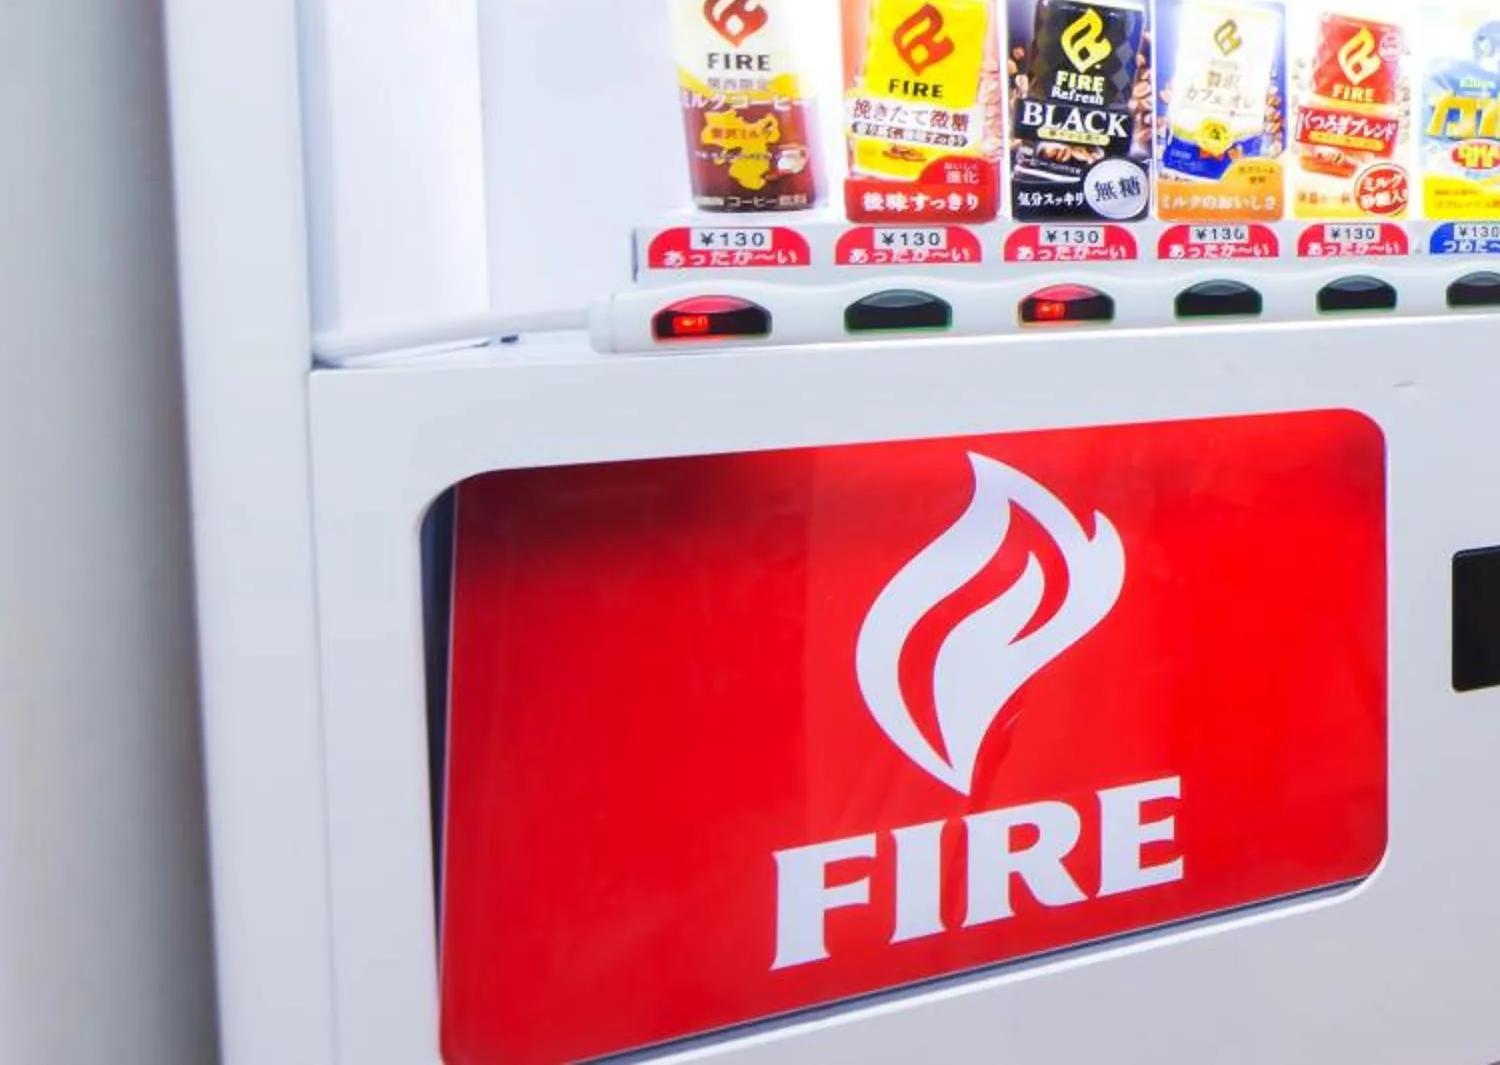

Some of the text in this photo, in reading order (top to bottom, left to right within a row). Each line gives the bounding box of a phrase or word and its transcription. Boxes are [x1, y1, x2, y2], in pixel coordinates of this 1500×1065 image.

[707, 51, 771, 72] FIRE
[888, 78, 944, 99] FIRE
[1057, 70, 1106, 95] FIRE
[1051, 88, 1105, 106] Refresh
[1332, 84, 1375, 102] FIRE
[1021, 100, 1131, 139] BLACK
[1093, 178, 1142, 202] 無糖
[862, 191, 979, 212] 後味すっきり
[1017, 190, 1084, 209] 気分スッキリ
[700, 231, 766, 247] ¥130
[881, 231, 941, 247] ¥130
[1045, 229, 1100, 244] ¥130
[1195, 226, 1247, 242] ¥130
[1331, 227, 1376, 240] ¥130
[1458, 225, 1500, 237] ¥130
[770, 775, 1184, 972] FIRE
